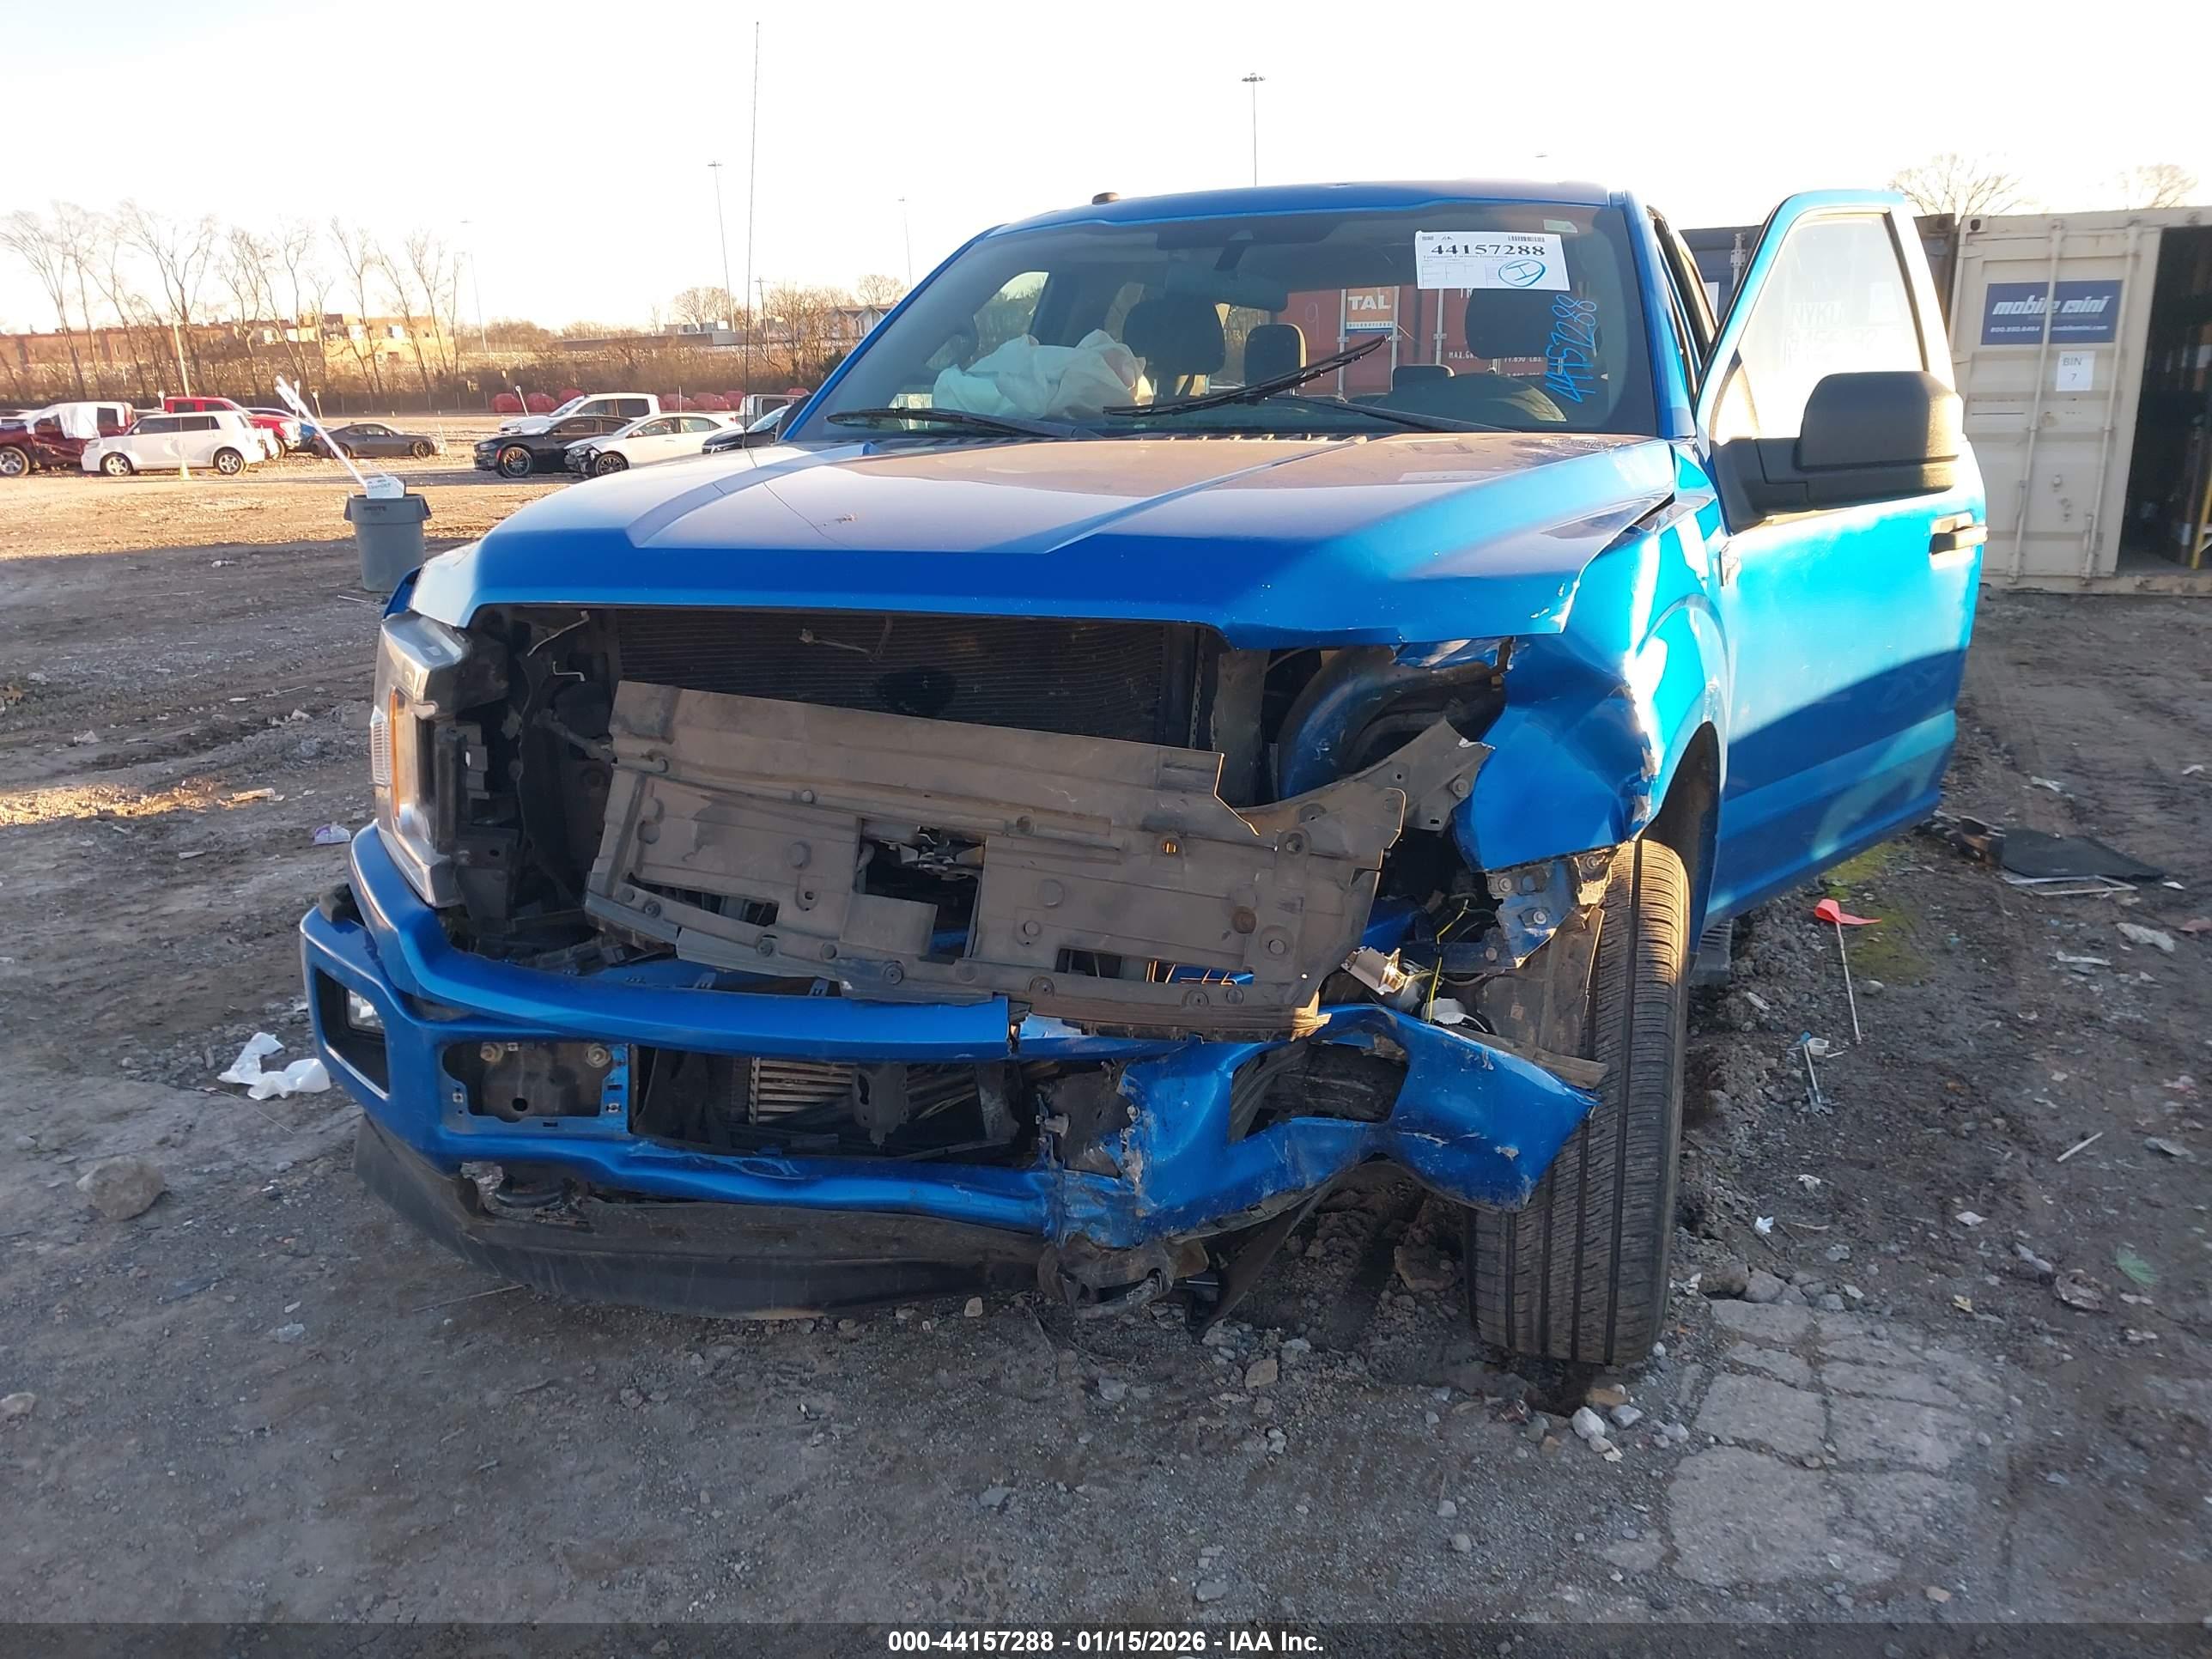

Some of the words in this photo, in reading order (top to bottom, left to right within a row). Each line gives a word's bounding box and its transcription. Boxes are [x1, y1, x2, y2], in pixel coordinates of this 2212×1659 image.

[1431, 244, 1547, 256] 44157288
[1347, 295, 1392, 310] TAL
[1992, 295, 2061, 315] mobile
[2061, 295, 2113, 313] mini
[1544, 294, 1597, 403] 44157288
[2063, 356, 2082, 366] BIN
[2070, 373, 2078, 382] 7
